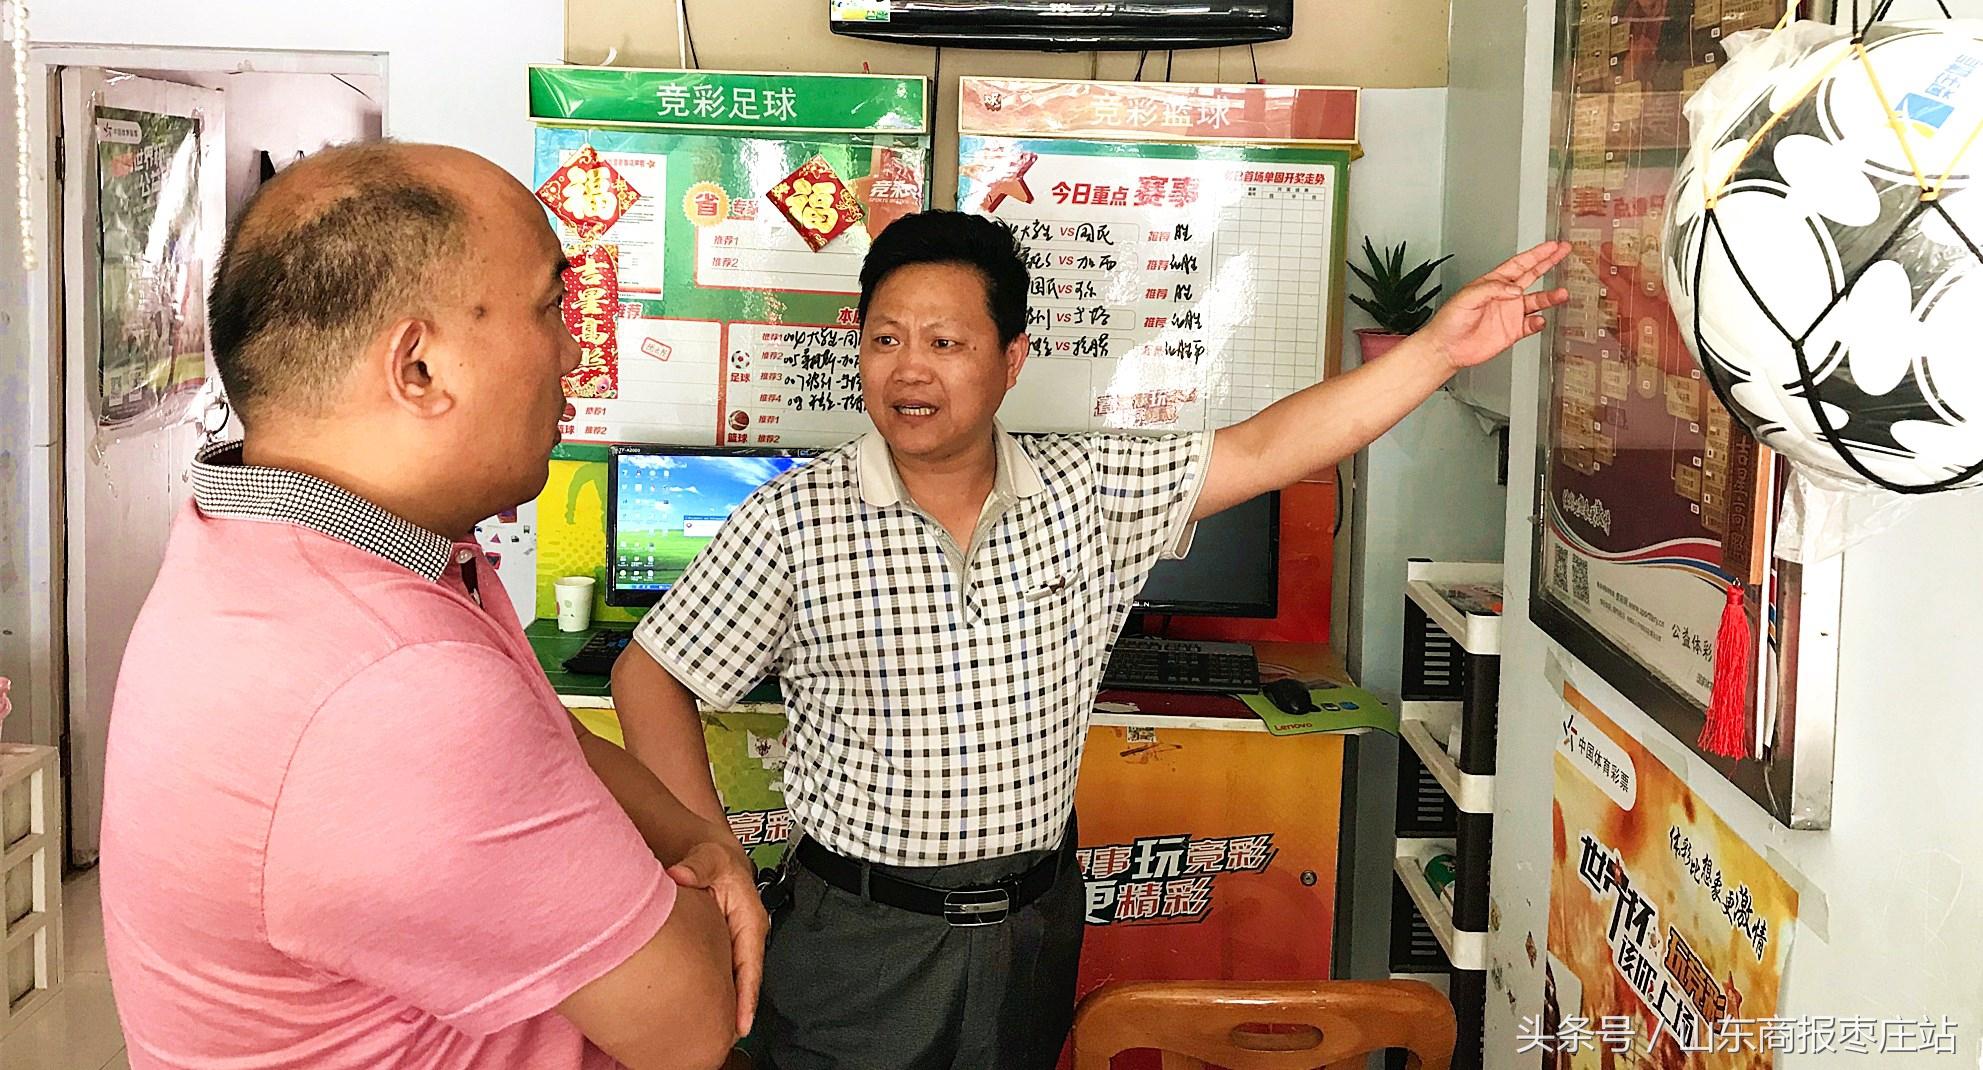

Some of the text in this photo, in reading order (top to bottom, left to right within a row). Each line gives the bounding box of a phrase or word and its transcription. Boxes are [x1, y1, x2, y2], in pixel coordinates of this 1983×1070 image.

[656, 84, 798, 121] 竞彩足球
[1091, 94, 1232, 129] 竞彩篮球
[1226, 170, 1325, 185] 首场单固开奖走势
[562, 166, 618, 221] 福
[695, 193, 719, 217] 省
[784, 177, 839, 234] 福
[1060, 227, 1076, 237] VS
[1147, 231, 1170, 242] 推荐
[714, 235, 739, 246] 推荐1
[712, 257, 739, 268] 推荐2
[1059, 256, 1074, 266] VS
[1146, 260, 1169, 271] 推荐
[1058, 285, 1073, 294] VS
[1145, 288, 1168, 299] 推荐
[569, 256, 610, 373] 吉星高照
[1056, 313, 1072, 323] VS
[1143, 317, 1168, 328] 推荐
[762, 333, 783, 341] 推荐1
[1055, 342, 1070, 351] VS
[762, 352, 784, 361] 推荐2
[730, 372, 751, 383] 足球
[760, 372, 783, 381] 推荐3
[759, 394, 782, 403] 推荐4
[758, 415, 780, 424] 推荐1
[584, 426, 608, 435] 推荐2
[727, 433, 748, 443] 篮球
[758, 434, 781, 444] 推荐2
[1671, 624, 1713, 663] 公益体彩
[1274, 722, 1313, 732] Lenovo
[1578, 736, 1630, 793] 中国体育彩票
[1581, 835, 1655, 948] 世界杯
[1669, 825, 1768, 960] 体彩比想象更激情
[1617, 935, 1696, 1048] 该你上场
